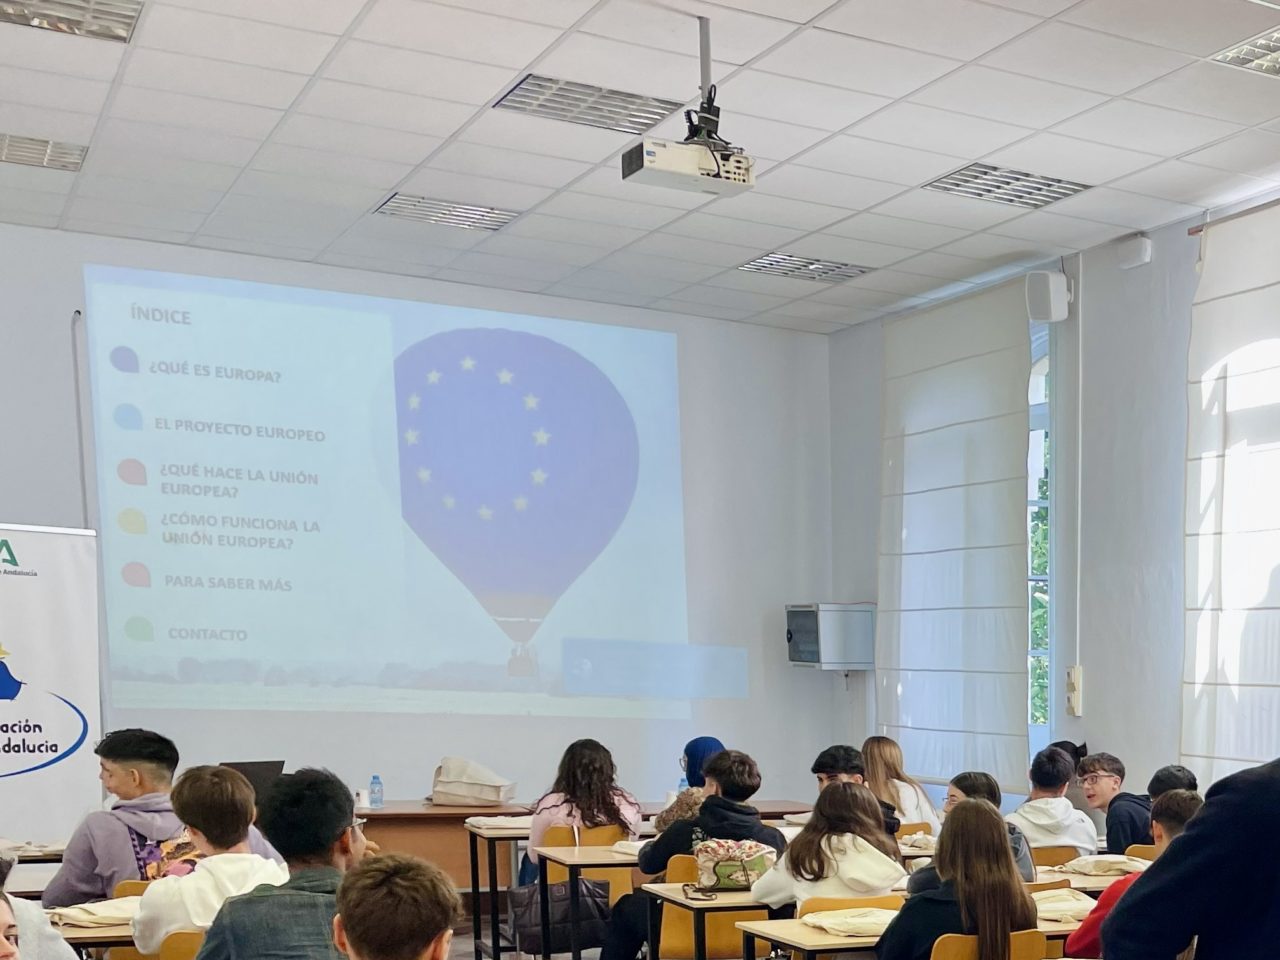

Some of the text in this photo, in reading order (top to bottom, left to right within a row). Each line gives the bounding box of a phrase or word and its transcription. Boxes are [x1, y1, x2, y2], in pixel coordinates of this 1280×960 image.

[131, 303, 192, 325] ÍNDICE
[149, 361, 281, 383] ¿QUÉ ES EUROPA?
[155, 417, 325, 442] EL PROYECTO EUROPEO
[160, 463, 319, 485] ¿QUÉ HACE LA UNIÓN
[161, 482, 239, 499] EUROPEA?
[161, 511, 320, 533] ¿CÓMO FUNCIONA LA
[162, 530, 294, 550] UNIÓN EUROPEA?
[164, 575, 292, 592] PARA SABER MÁS
[168, 628, 248, 642] CONTACTO
[0, 736, 58, 753] dalucia
